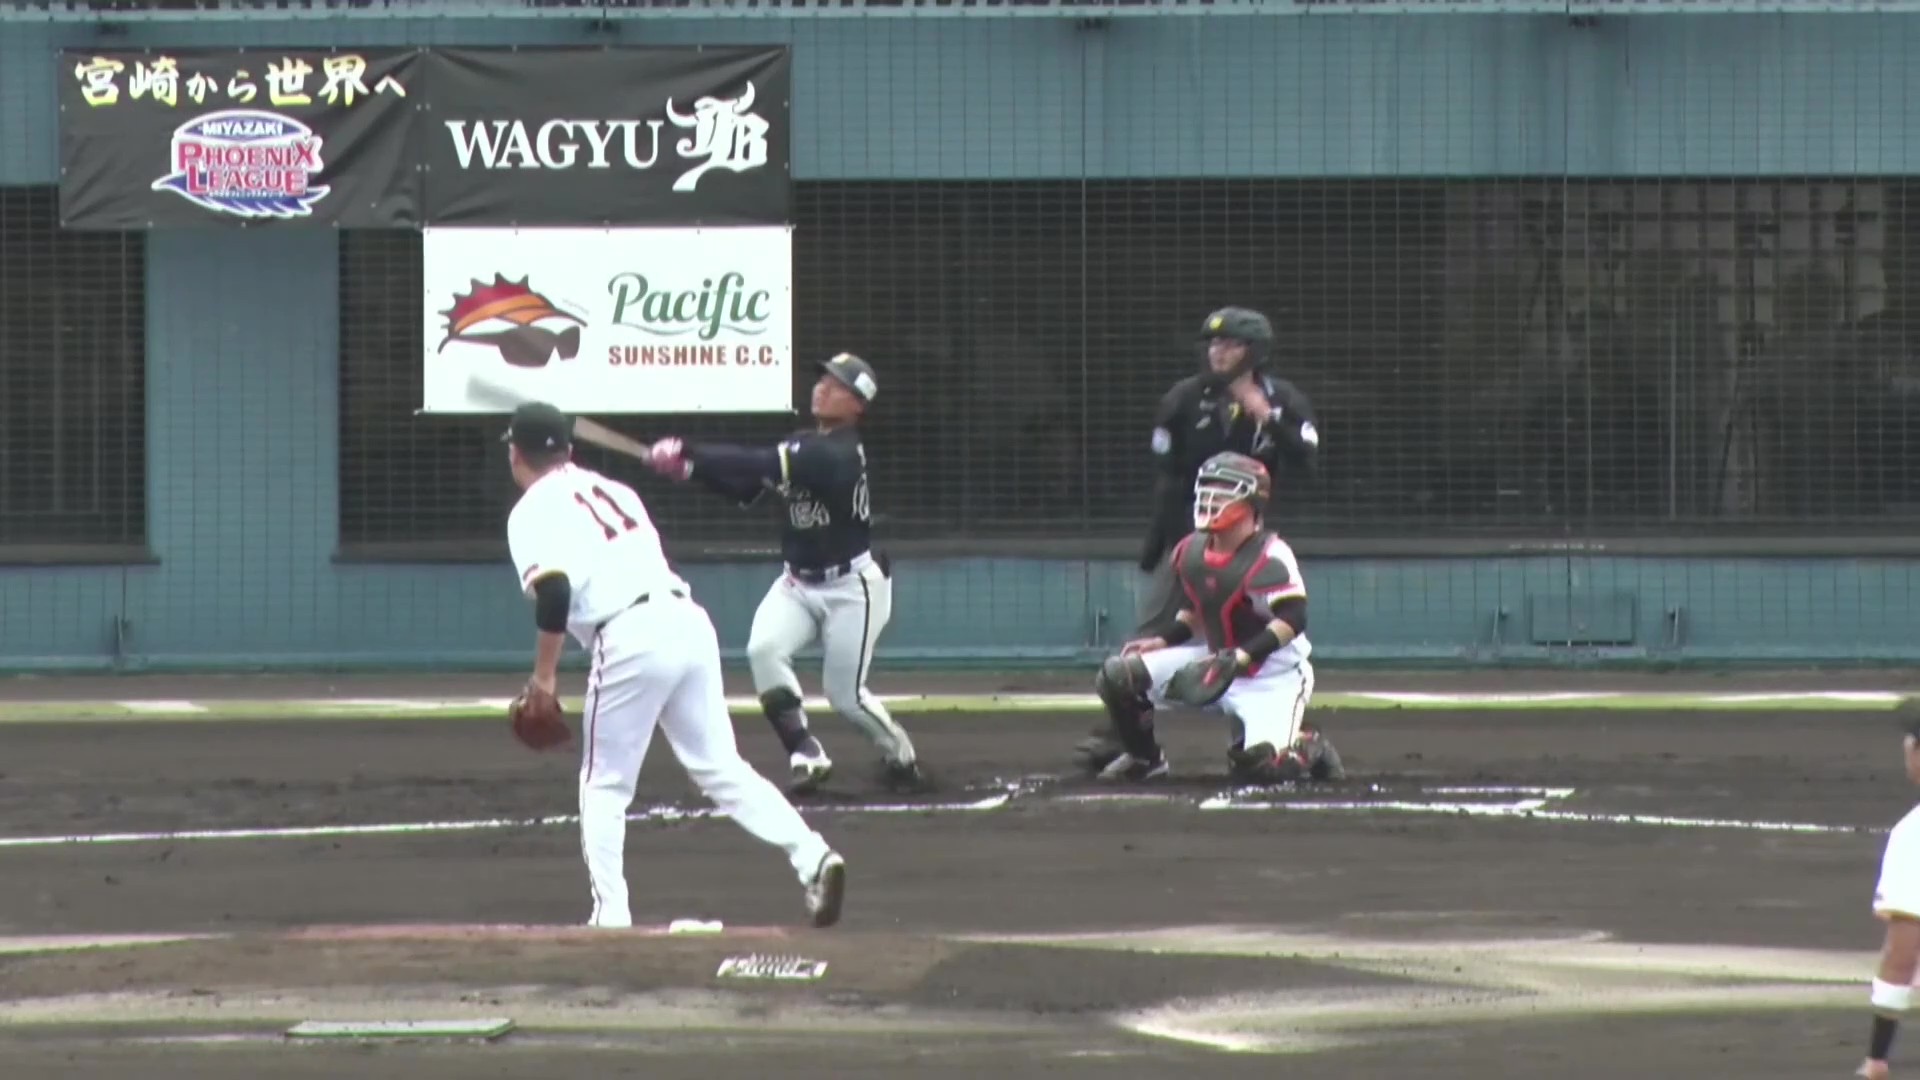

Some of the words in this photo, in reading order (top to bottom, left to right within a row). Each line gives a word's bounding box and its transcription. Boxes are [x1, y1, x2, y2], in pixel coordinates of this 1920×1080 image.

[75, 55, 405, 107] 宮崎から世界へ
[202, 121, 284, 136] MIYAZAKI
[445, 119, 663, 169] WAGYU
[178, 141, 315, 171] PHOENIX
[187, 163, 308, 196] LEAGUE
[607, 271, 770, 341] Pacific
[608, 345, 727, 366] SUNSHINE
[735, 345, 780, 366] C.C.
[574, 485, 638, 541] 11
